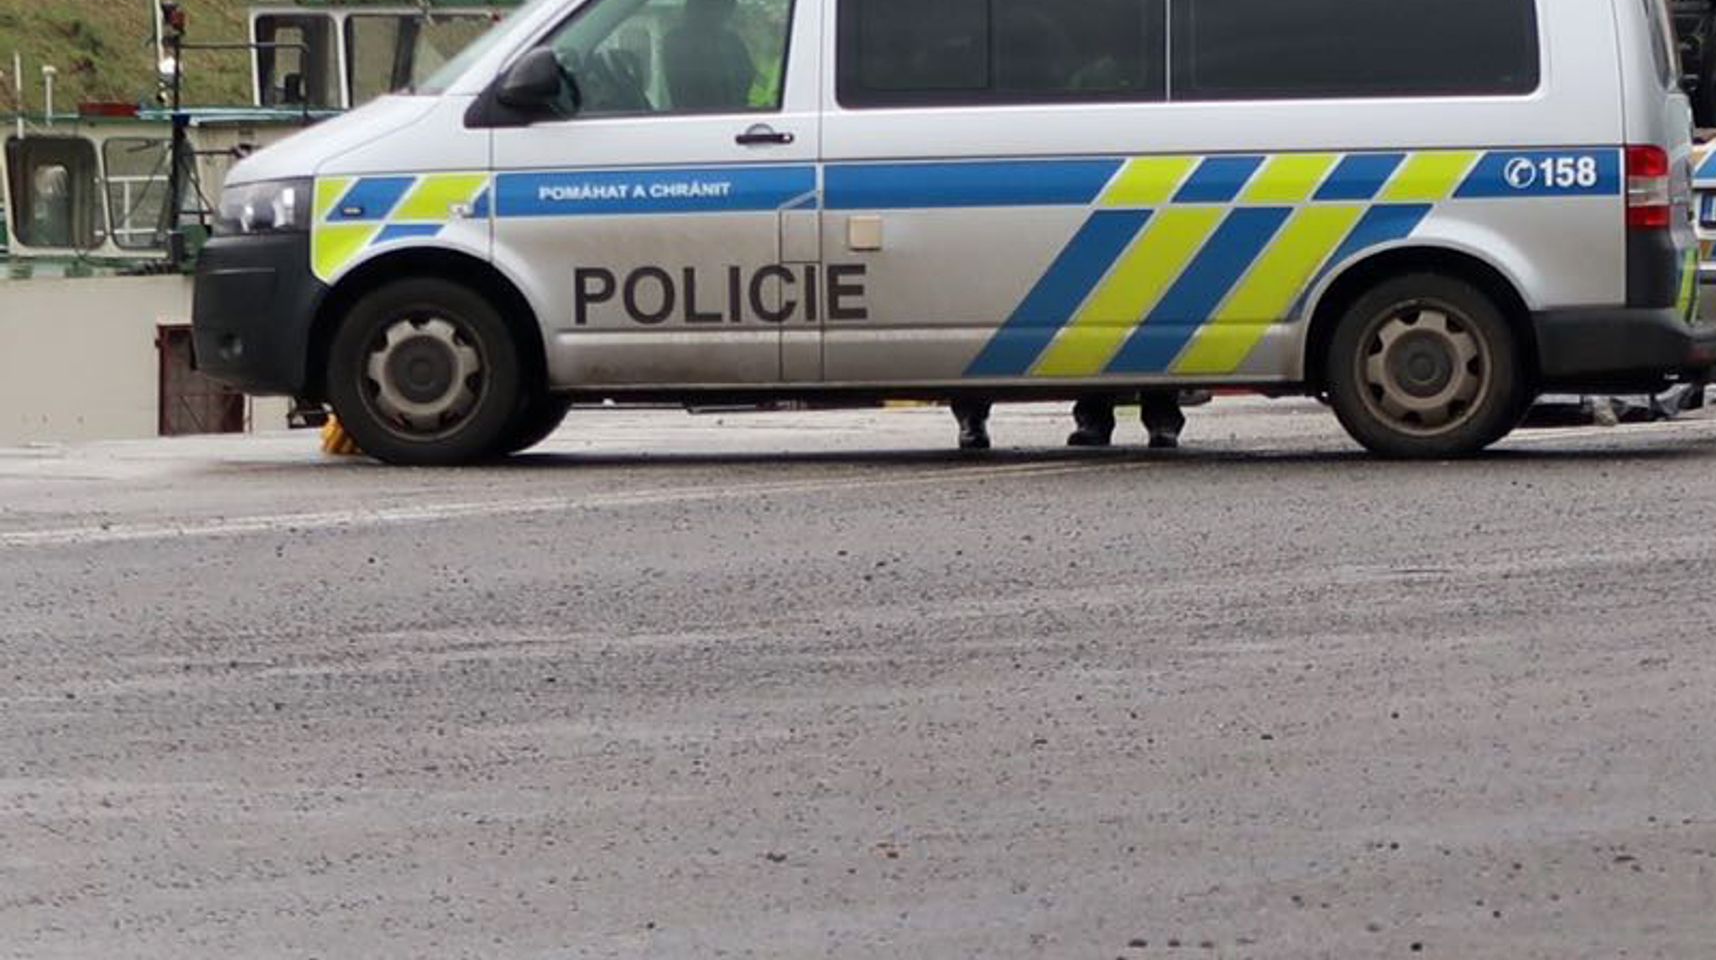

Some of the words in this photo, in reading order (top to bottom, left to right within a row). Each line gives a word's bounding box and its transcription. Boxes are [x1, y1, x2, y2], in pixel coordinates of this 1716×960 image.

[1540, 156, 1597, 187] 158
[539, 184, 628, 200] POMÁHAT
[633, 186, 647, 198] A
[650, 181, 731, 198] CHRÁNIT
[574, 264, 868, 325] POLICIE
